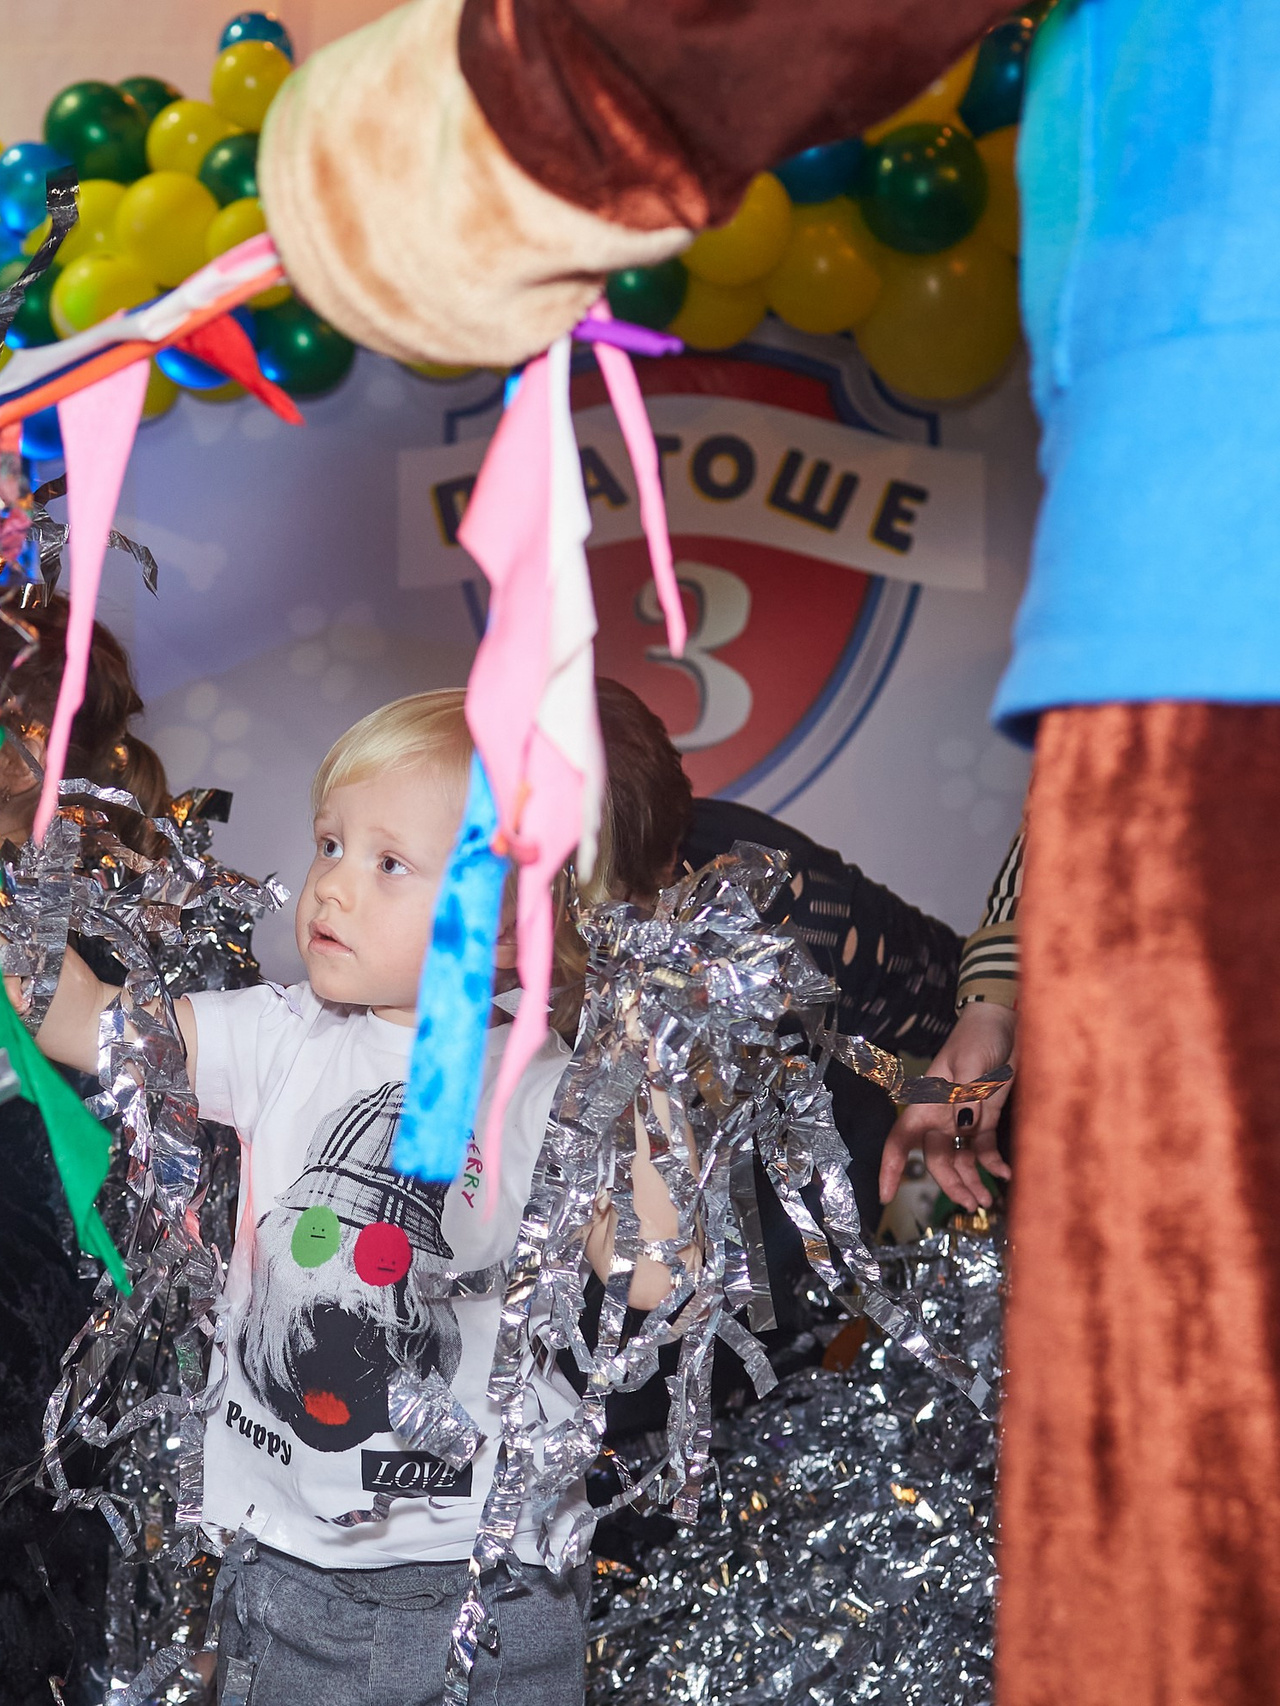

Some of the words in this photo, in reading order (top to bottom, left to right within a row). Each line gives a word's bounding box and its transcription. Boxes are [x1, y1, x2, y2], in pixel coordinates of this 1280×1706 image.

[634, 561, 752, 753] 3
[226, 1400, 292, 1466] Puppy
[371, 1459, 457, 1489] LOVE
